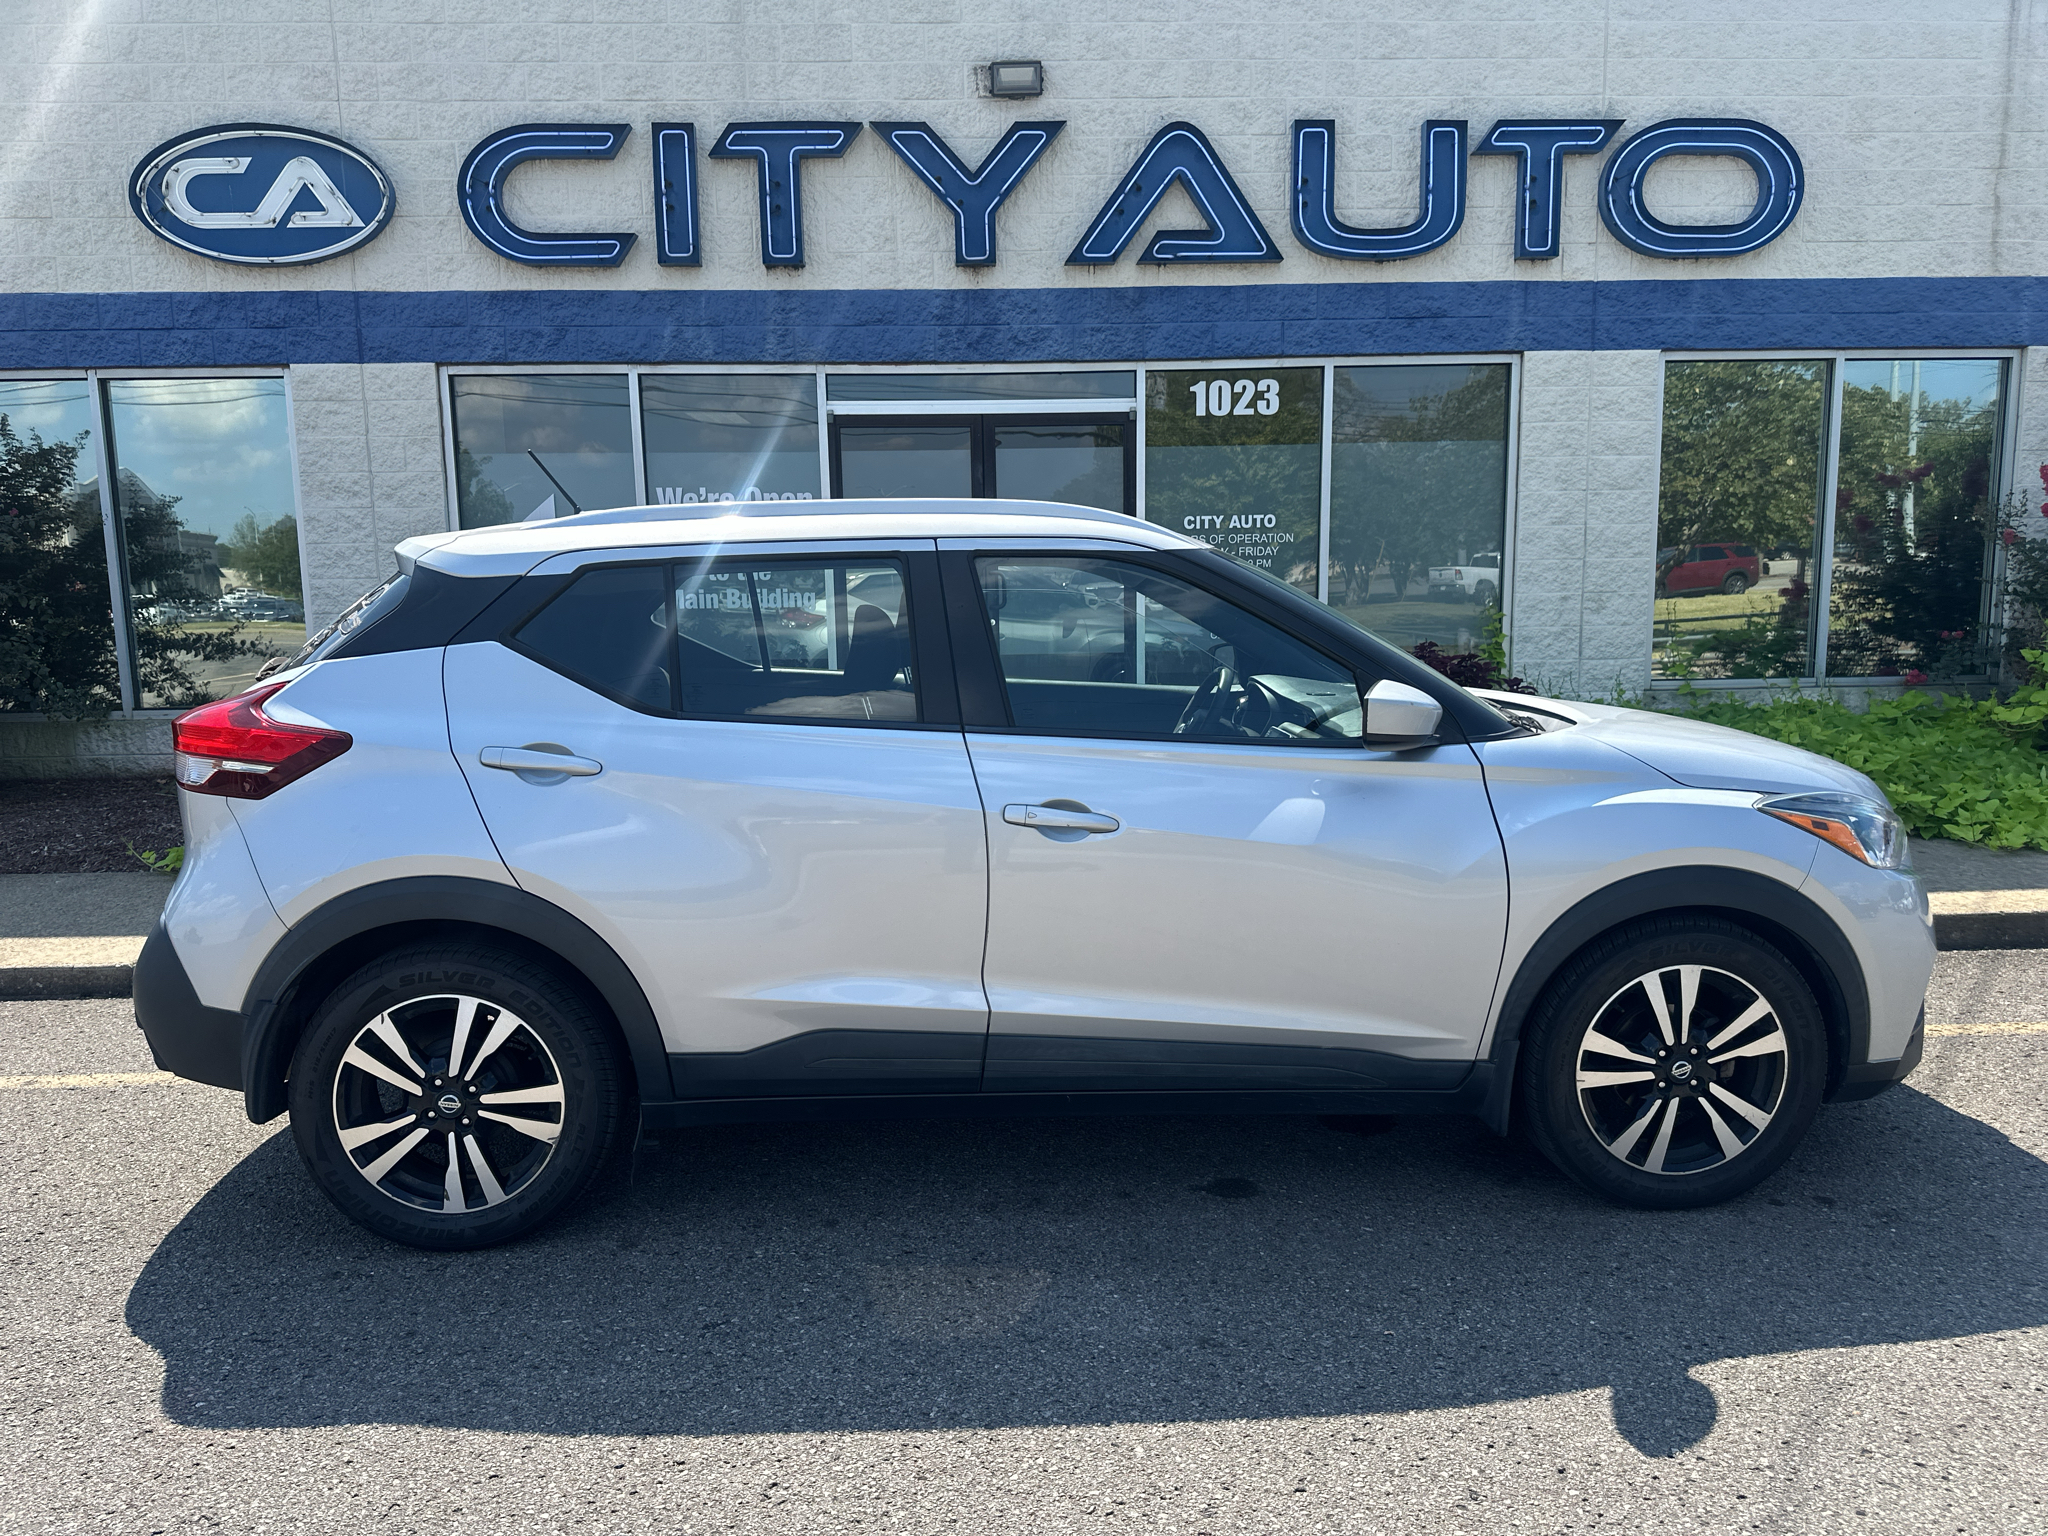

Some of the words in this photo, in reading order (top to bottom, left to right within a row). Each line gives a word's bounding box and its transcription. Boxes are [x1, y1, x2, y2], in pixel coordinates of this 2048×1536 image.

[162, 156, 366, 229] CA
[457, 120, 1068, 267] CITY
[1063, 118, 1805, 266] AUTO
[1189, 378, 1280, 417] 1023
[1183, 514, 1224, 530] CITY
[1229, 513, 1277, 529] AUTO
[1209, 534, 1225, 544] OF
[1228, 533, 1294, 544] OPERATION
[1238, 546, 1280, 556] FRIDAY
[1255, 558, 1272, 568] PM
[398, 970, 496, 991] SILVER
